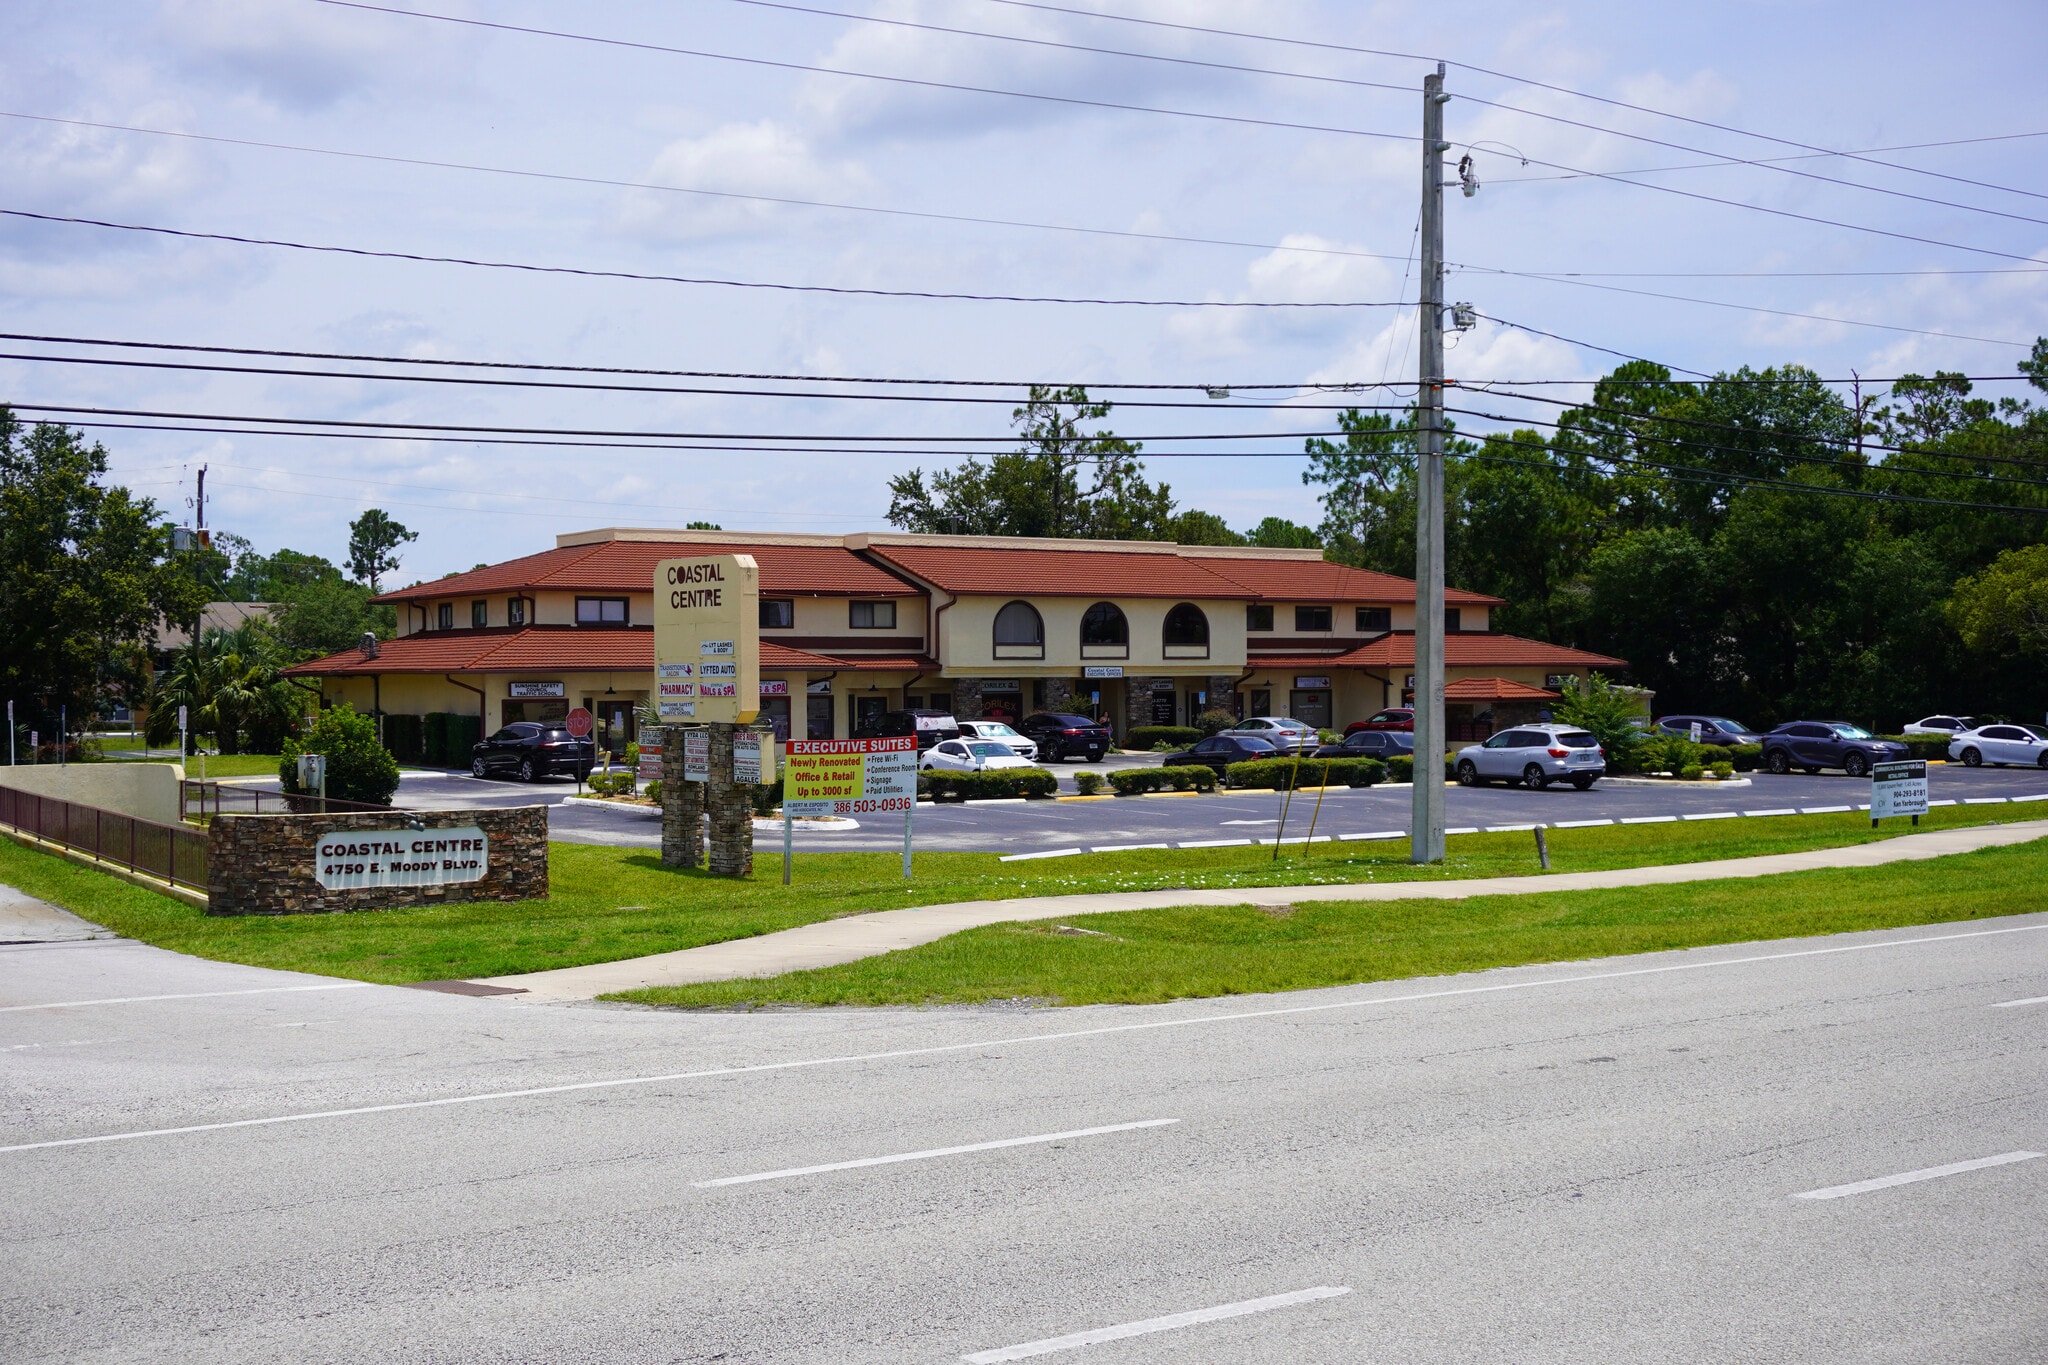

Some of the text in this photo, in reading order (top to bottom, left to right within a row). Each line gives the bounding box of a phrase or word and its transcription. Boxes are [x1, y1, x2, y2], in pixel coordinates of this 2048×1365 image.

[667, 563, 725, 585] COASTAL
[671, 588, 722, 609] CENTRE
[700, 664, 735, 675] LYFTED AUTO
[660, 684, 693, 695] PHARMACY
[700, 684, 736, 696] NAILS & SPA
[771, 684, 786, 692] SPA
[568, 717, 590, 728] STOP
[793, 739, 912, 754] EXECUTIVE SUITES
[790, 756, 861, 769] Newly Renovated
[871, 754, 899, 763] Free Wi-Fi
[871, 764, 916, 774] Conference Room
[795, 771, 855, 782] Office & Retail
[870, 776, 892, 785] Signage
[797, 785, 852, 798] Up to 3000 sf
[870, 785, 903, 795] Paid Utilities
[833, 797, 911, 813] 386 503-0936
[321, 838, 483, 857] COASTAL CENTRE
[324, 863, 365, 875] 4750
[370, 862, 384, 873] E.
